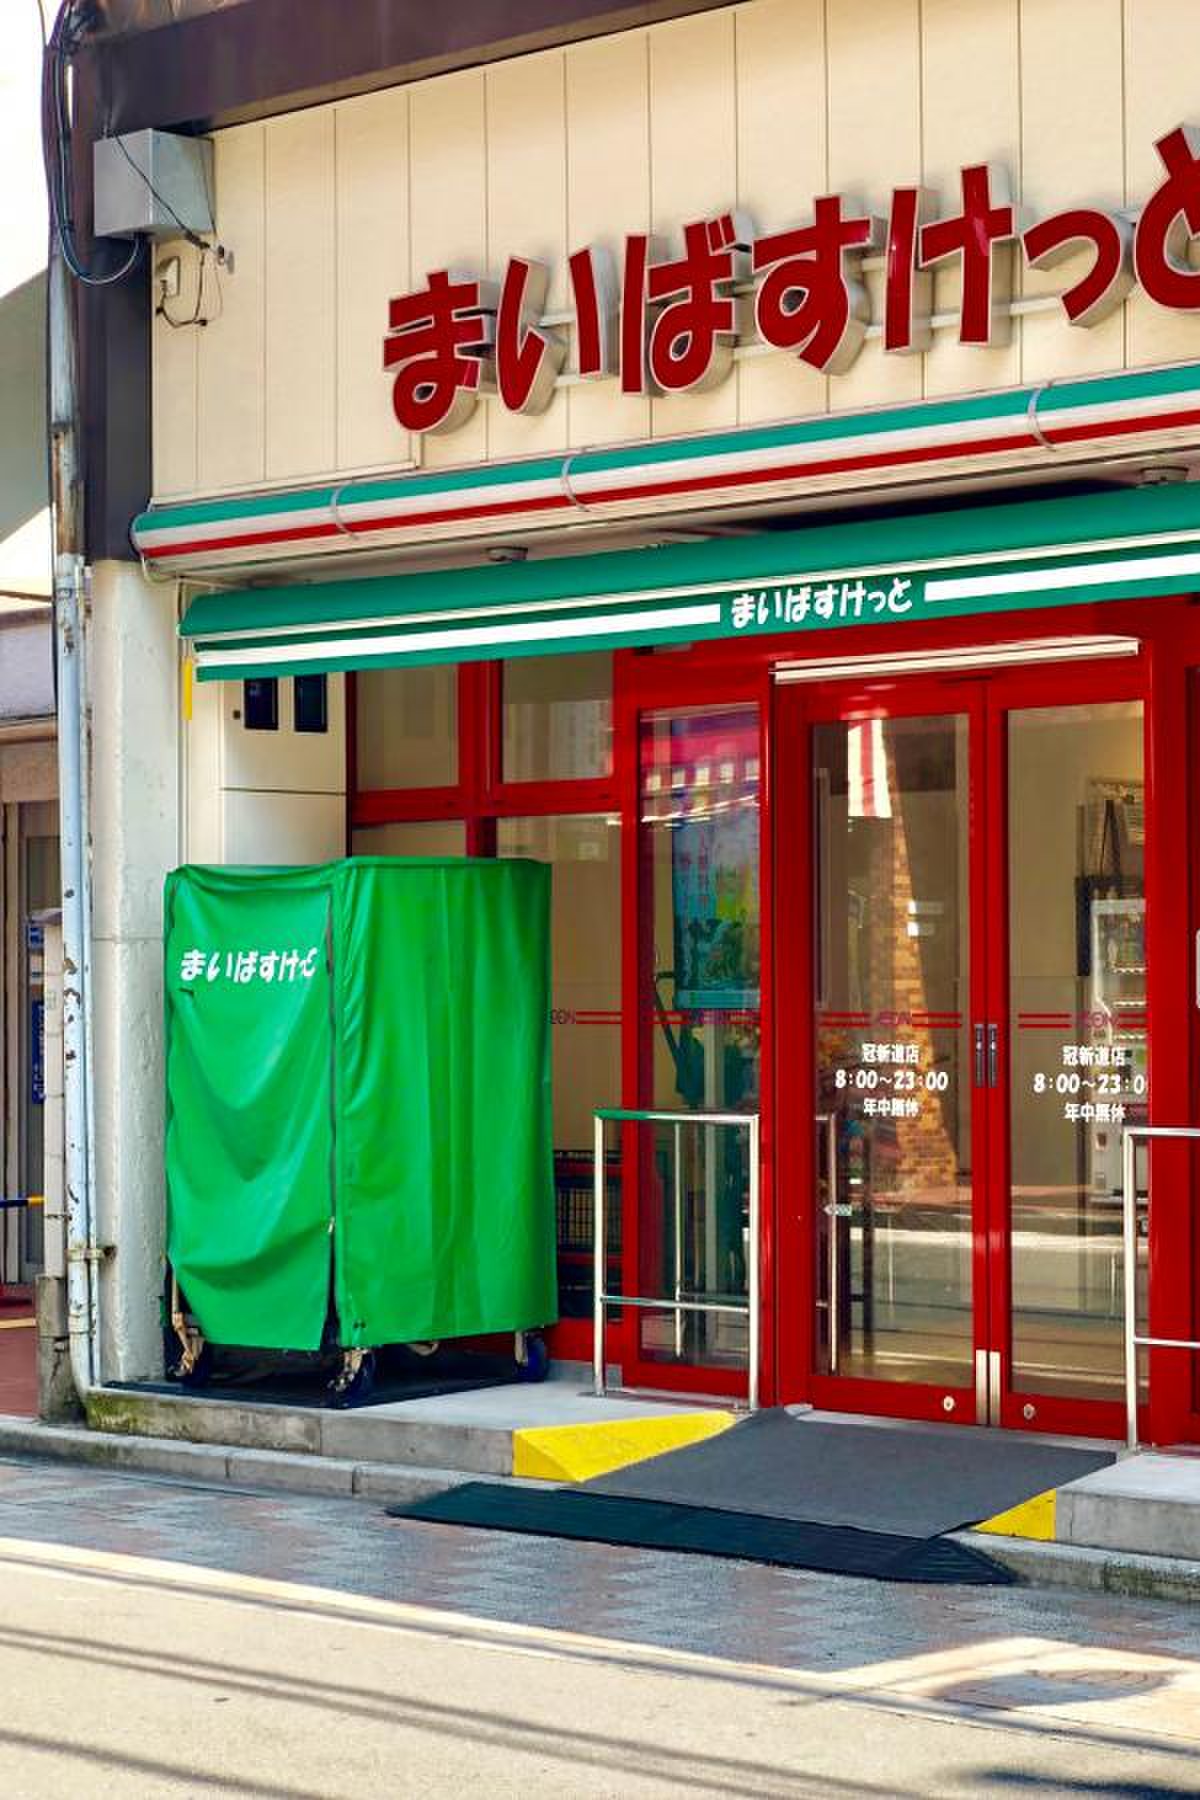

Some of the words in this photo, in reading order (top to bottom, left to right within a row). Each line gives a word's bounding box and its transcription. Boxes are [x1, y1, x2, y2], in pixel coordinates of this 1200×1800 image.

[731, 577, 913, 629] まいばすけっと
[180, 947, 318, 983] まいばすけと
[1033, 1073, 1146, 1095] 8:00~23:0
